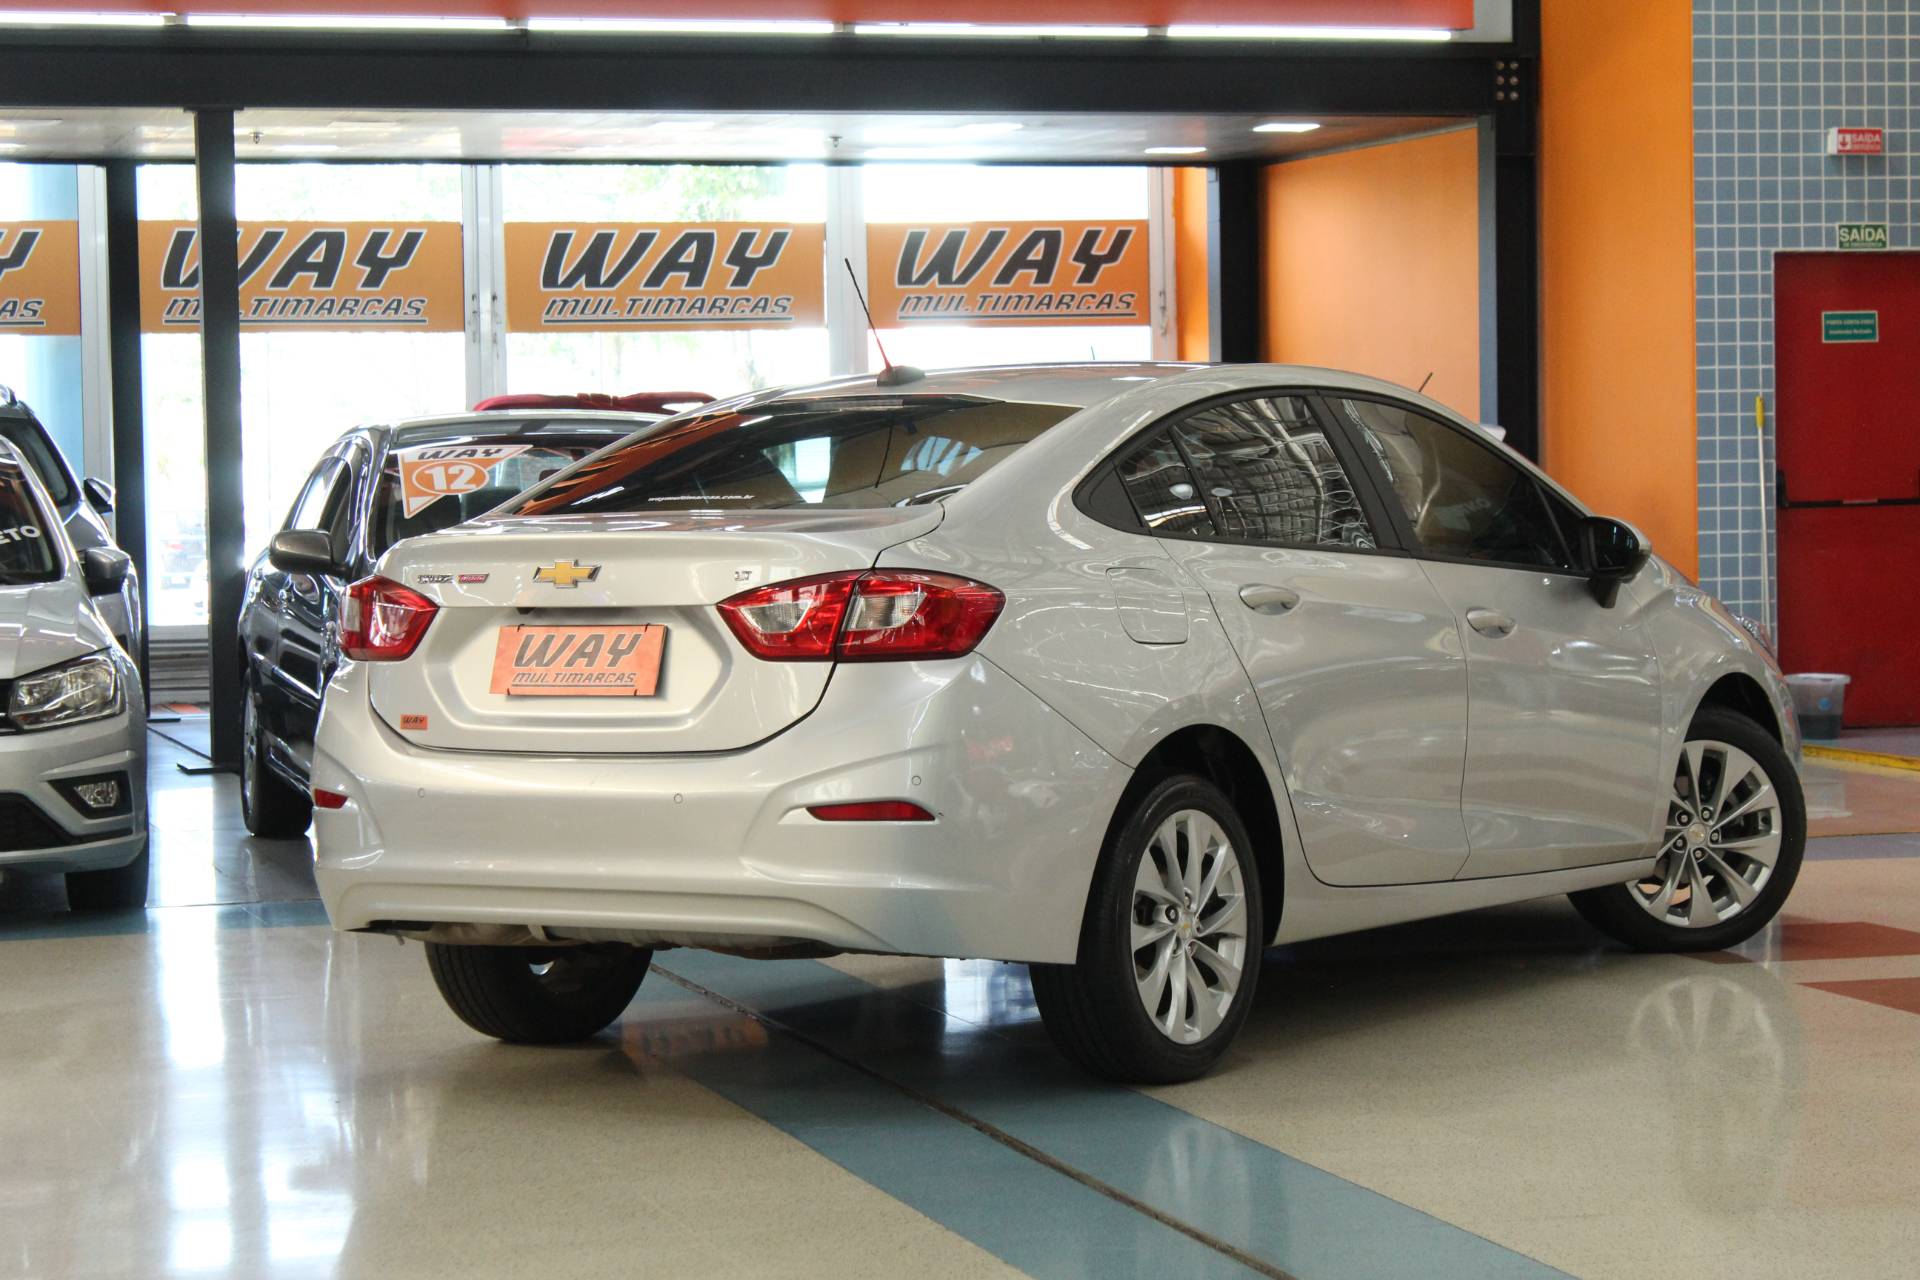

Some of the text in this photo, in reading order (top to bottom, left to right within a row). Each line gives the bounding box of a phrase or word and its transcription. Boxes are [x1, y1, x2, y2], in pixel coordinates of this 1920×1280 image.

[1839, 225, 1886, 242] SAÍDA
[161, 228, 427, 290] WAY
[540, 229, 792, 290] WAY
[895, 227, 1136, 288] WAY
[165, 297, 428, 318] MTIMARCAS
[543, 296, 793, 316] MULTIMARCAS
[899, 292, 1137, 314] MULTIMARCAS
[417, 447, 504, 461] WAY
[423, 464, 478, 491] 12
[513, 632, 644, 669] WAY
[512, 672, 638, 684] MULTIMARCAS
